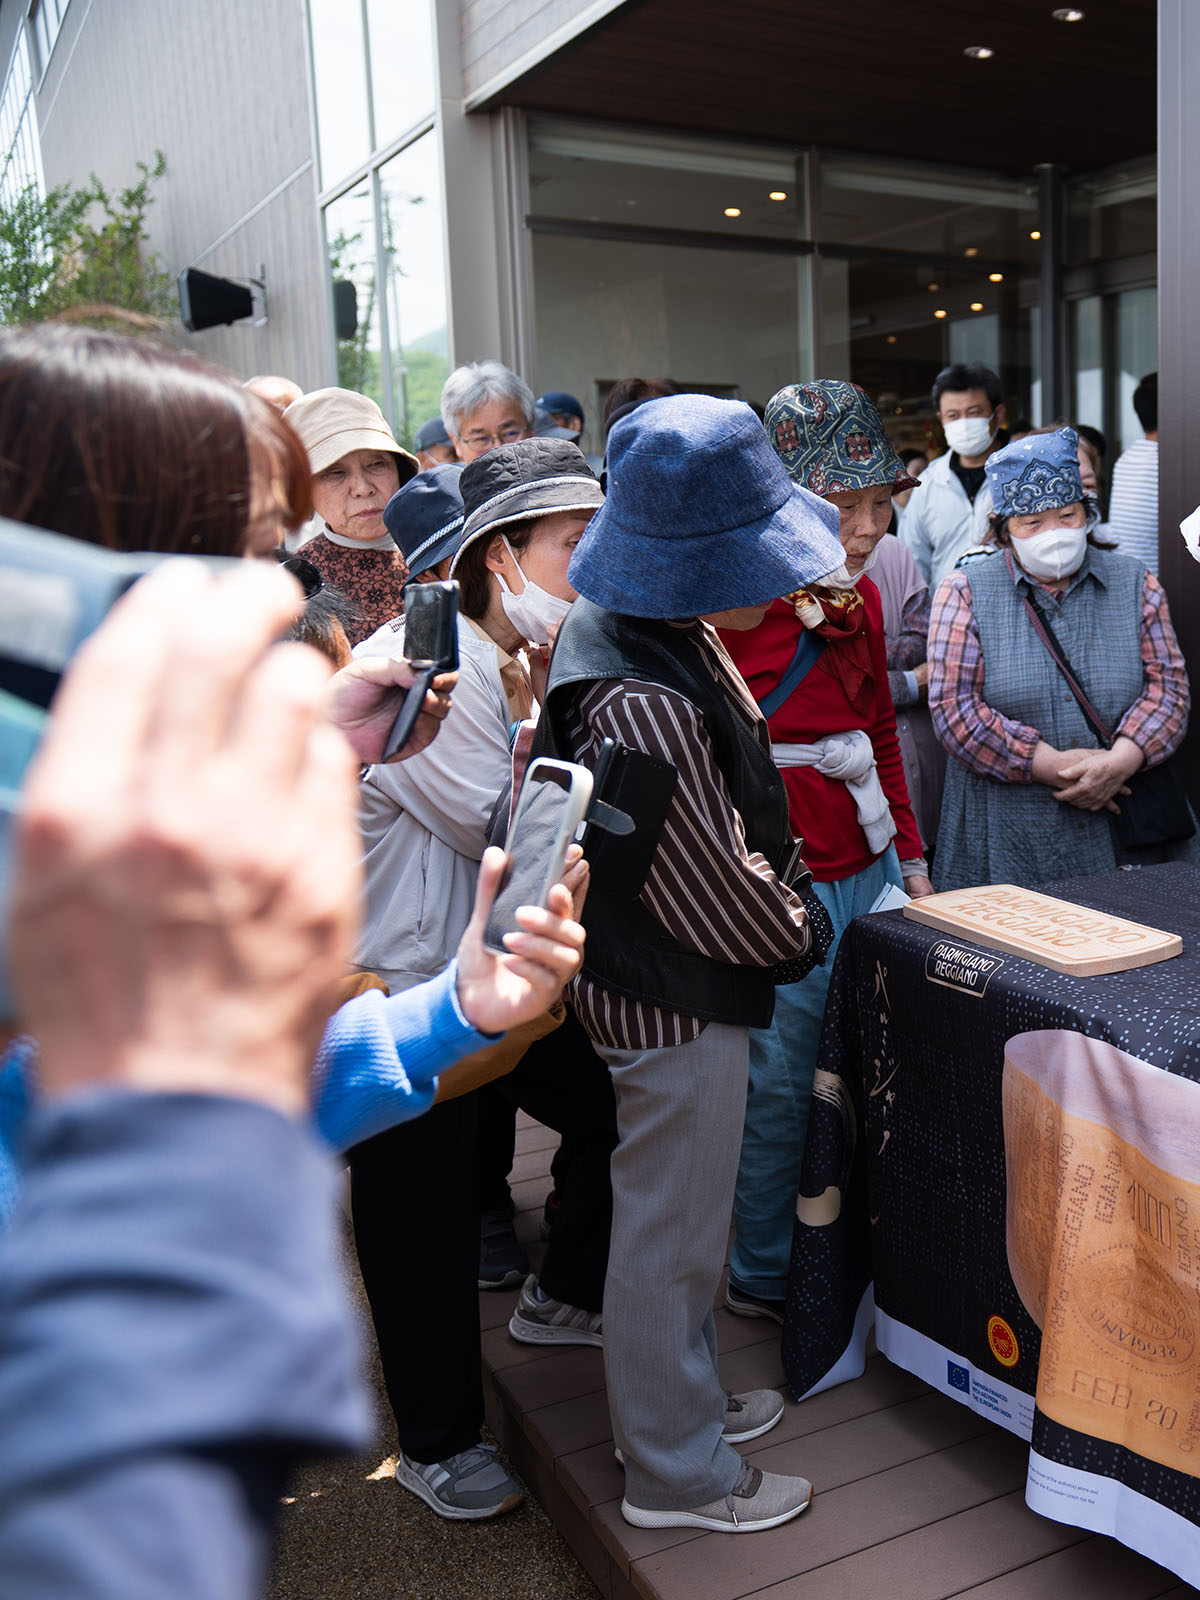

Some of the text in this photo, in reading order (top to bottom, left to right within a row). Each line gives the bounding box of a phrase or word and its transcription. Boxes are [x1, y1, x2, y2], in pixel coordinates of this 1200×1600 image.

[950, 901, 1094, 949] REGGIANO
[974, 889, 1147, 946] PARMIGIANO
[934, 943, 996, 973] PARMIGIANO
[934, 959, 979, 988] REGGIANO
[1071, 1368, 1179, 1431] FEB 20
